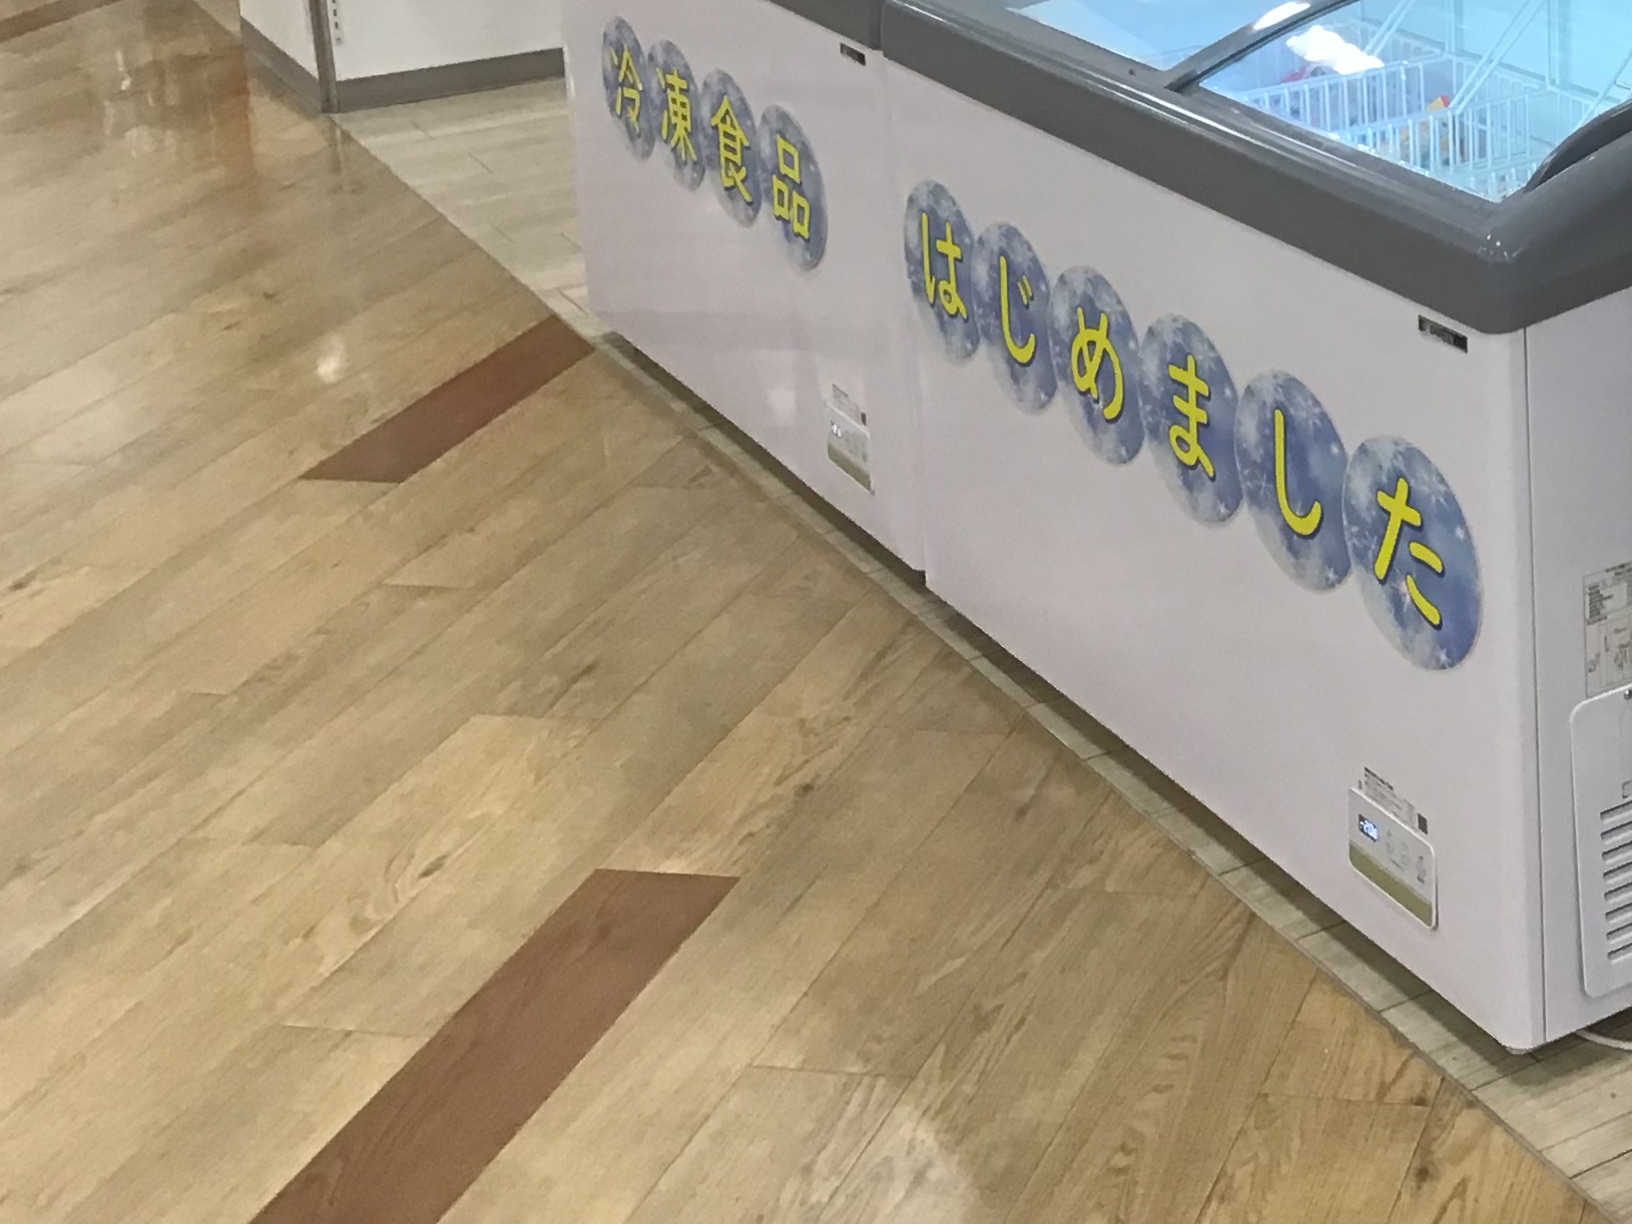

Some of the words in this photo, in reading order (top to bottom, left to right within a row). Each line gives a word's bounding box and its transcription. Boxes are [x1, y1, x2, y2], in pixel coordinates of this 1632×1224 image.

[922, 212, 1443, 628] はじめました
